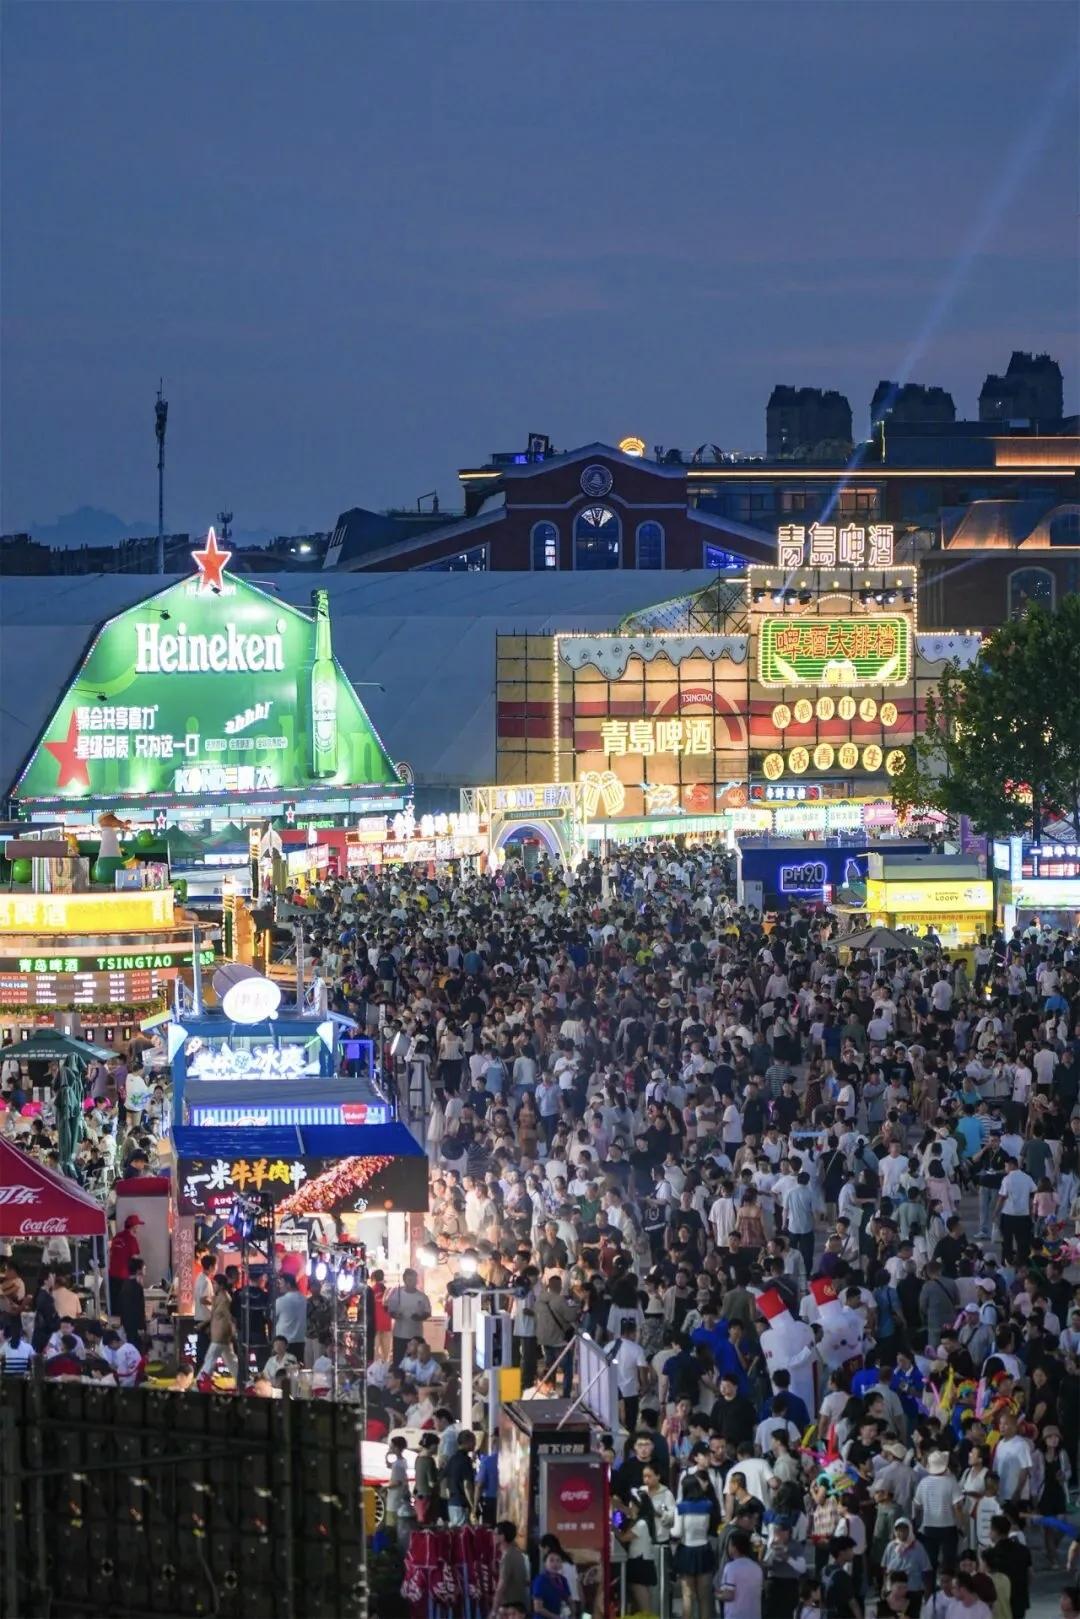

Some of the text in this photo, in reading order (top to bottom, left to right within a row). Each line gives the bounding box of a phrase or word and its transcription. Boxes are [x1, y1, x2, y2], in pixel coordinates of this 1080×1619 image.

[135, 621, 286, 674] Heineken
[776, 622, 896, 663] 啤酒大排档
[682, 692, 713, 703] TSINGTAO
[74, 734, 129, 759] 星级品质
[135, 733, 200, 758] 只为这一口
[19, 957, 80, 973] 青岛啤酒
[97, 955, 173, 970] TSINGTAO
[186, 1157, 308, 1191] 一米牛羊肉串
